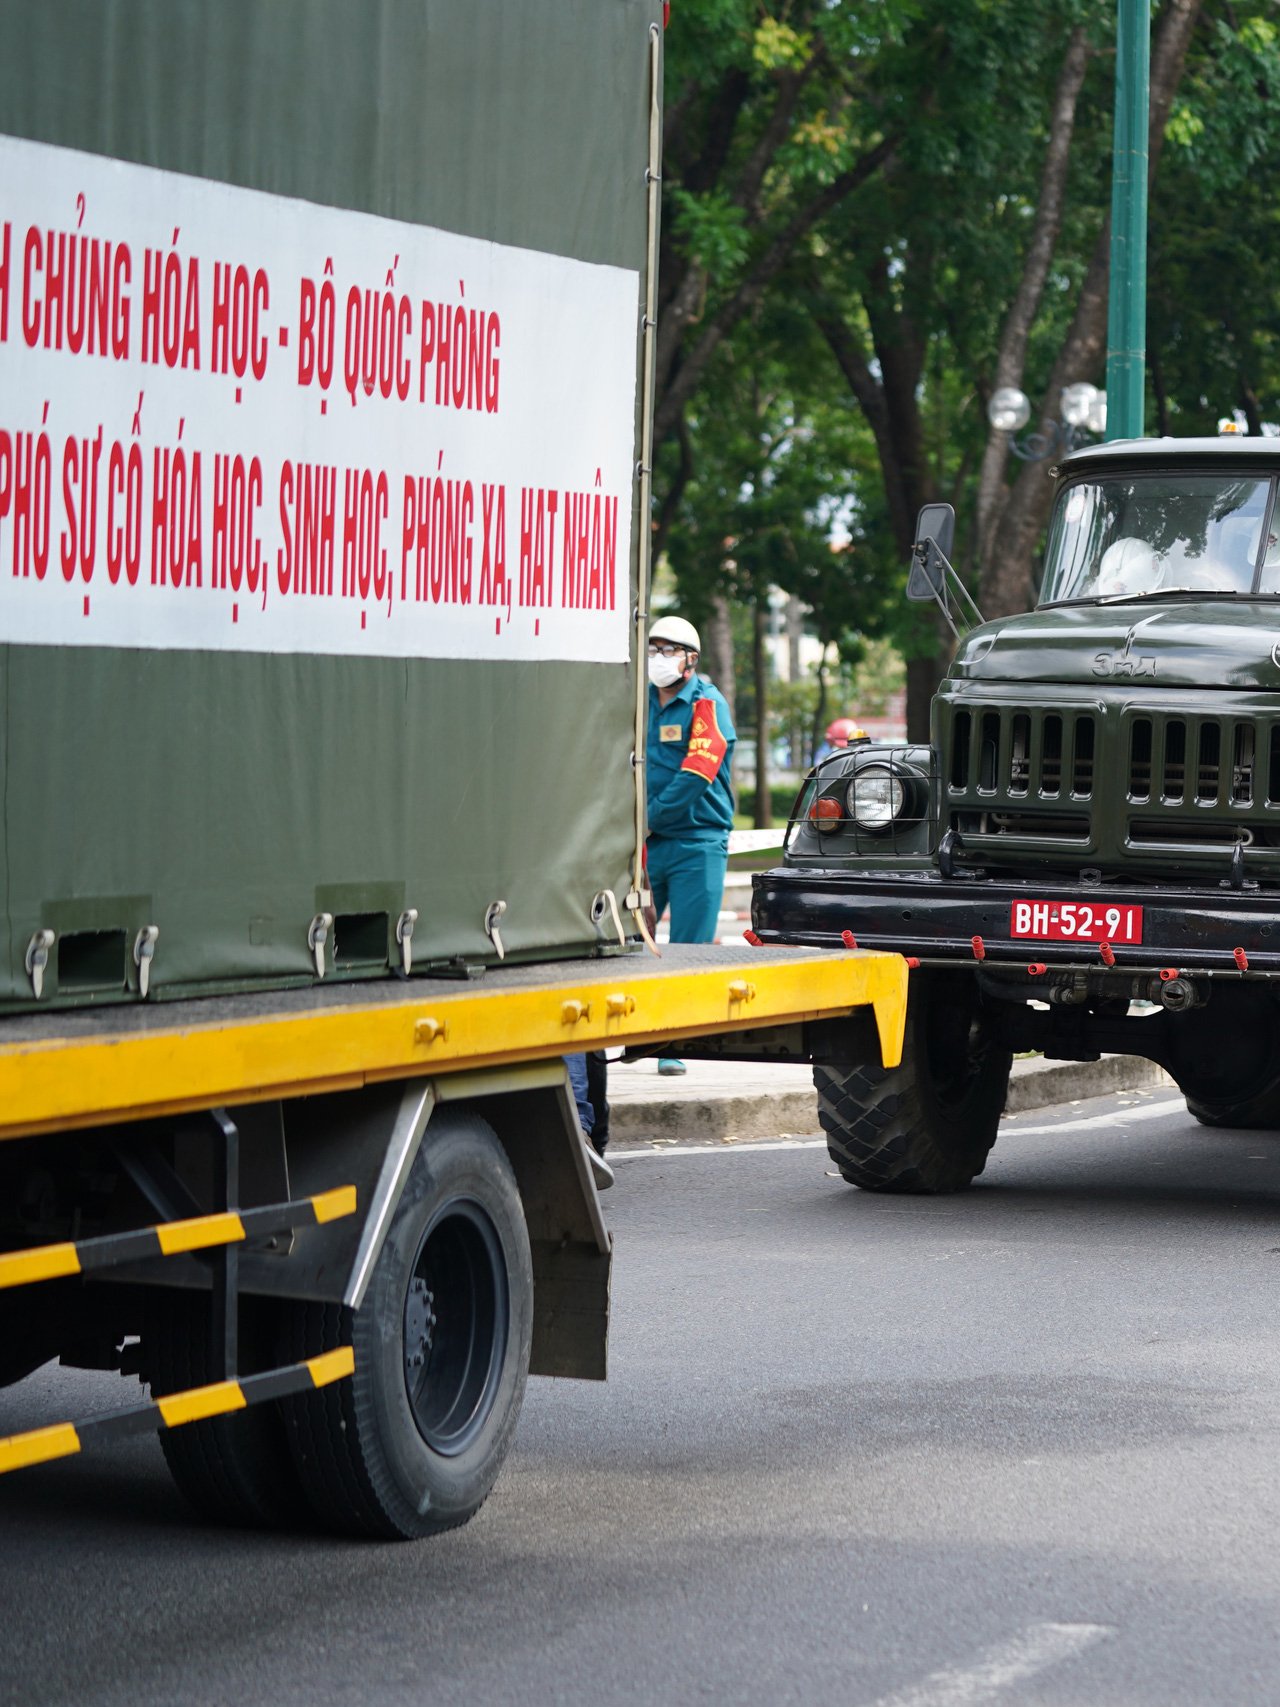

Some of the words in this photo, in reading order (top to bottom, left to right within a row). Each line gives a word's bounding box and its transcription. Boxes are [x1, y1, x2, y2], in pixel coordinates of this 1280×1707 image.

[22, 191, 132, 362] CHỦNG
[142, 226, 201, 371] HÓA
[211, 261, 270, 405] HỌC
[297, 256, 336, 416] BỘ
[343, 254, 413, 408] QUỐC
[419, 279, 501, 414] PHÒNG
[60, 423, 104, 618] SỰ
[106, 390, 144, 587] CỐ
[150, 417, 203, 590] HÓA
[211, 453, 269, 624] HỌC,
[276, 459, 337, 597] SINH
[341, 467, 394, 631] HỌC,
[400, 449, 475, 606] PHÓNG
[478, 482, 513, 636] XẠ,
[518, 487, 559, 637] HẠT
[561, 467, 619, 611] NHÂN
[1015, 903, 1133, 939] BH-52-91
